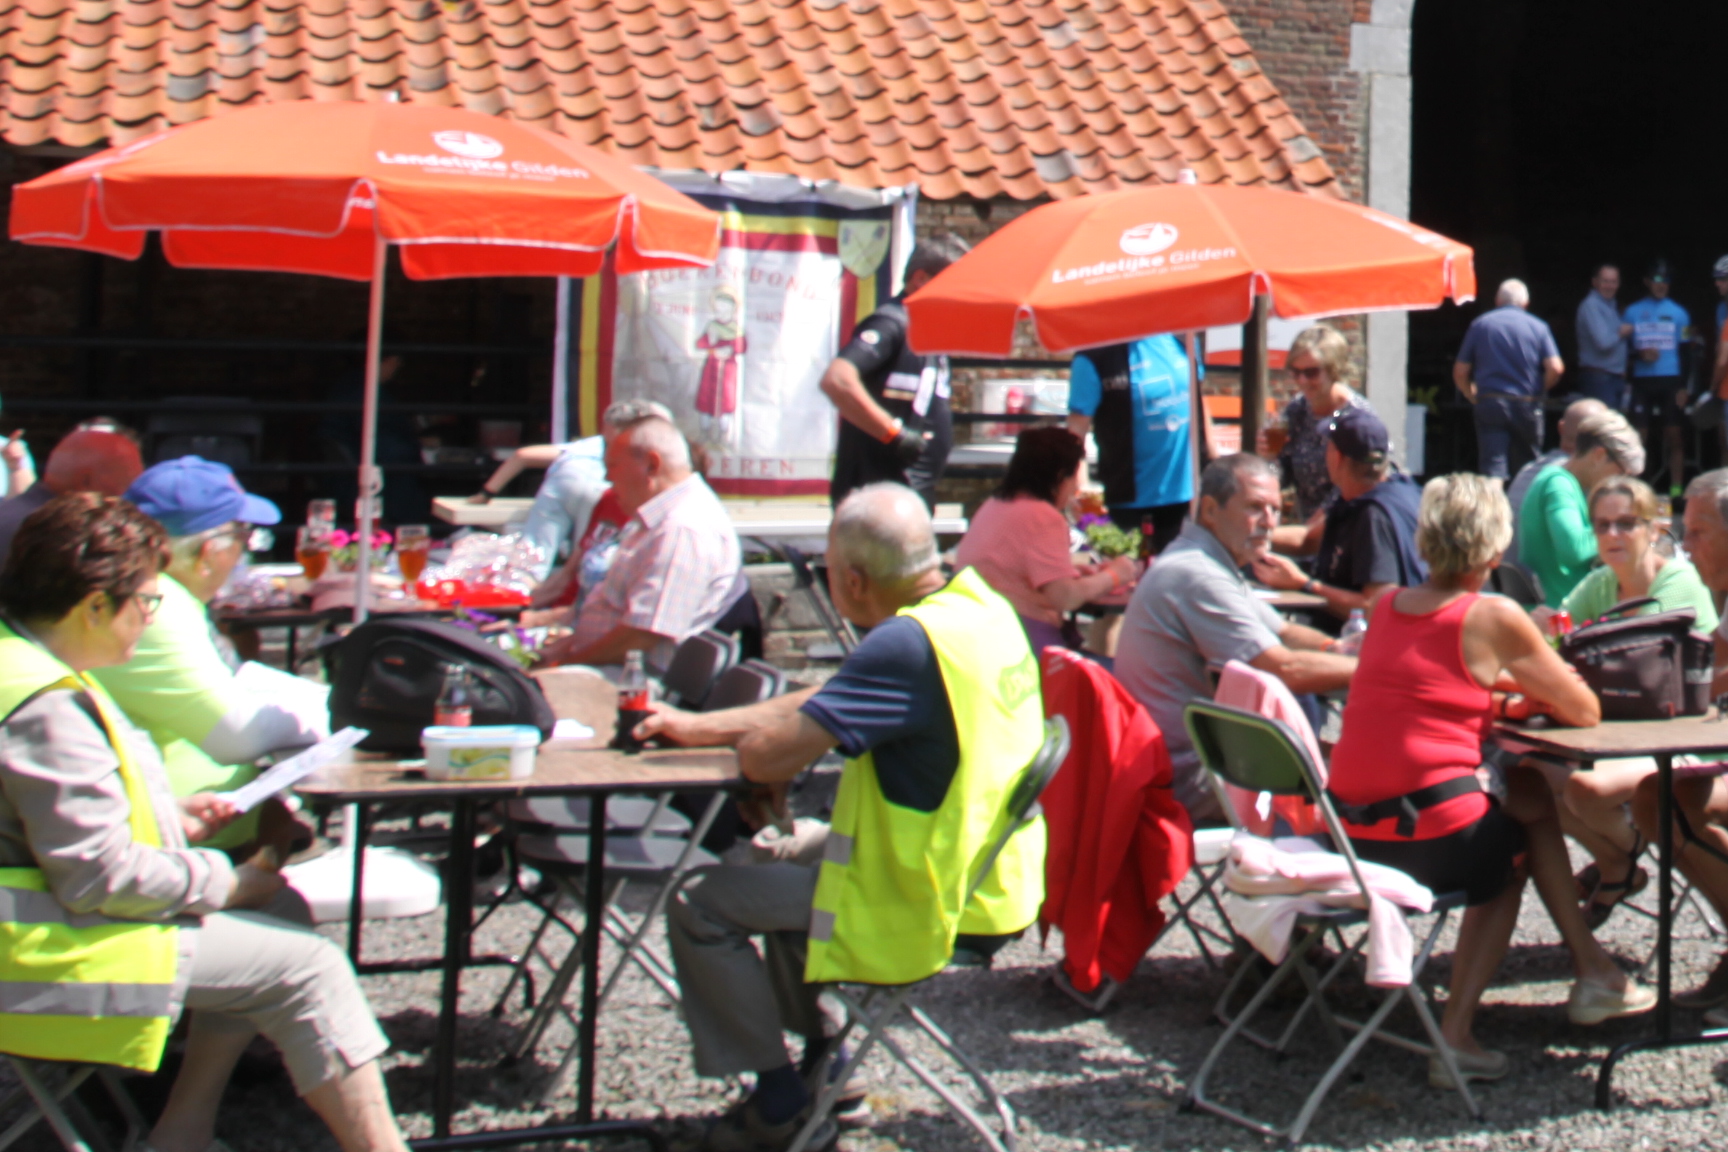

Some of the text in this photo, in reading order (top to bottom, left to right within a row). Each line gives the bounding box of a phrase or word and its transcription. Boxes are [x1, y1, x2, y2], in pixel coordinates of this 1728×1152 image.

[376, 151, 507, 172] Landelijke
[511, 160, 589, 179] Gilden
[1052, 254, 1165, 283] Landelijke
[1169, 247, 1237, 265] Gilden
